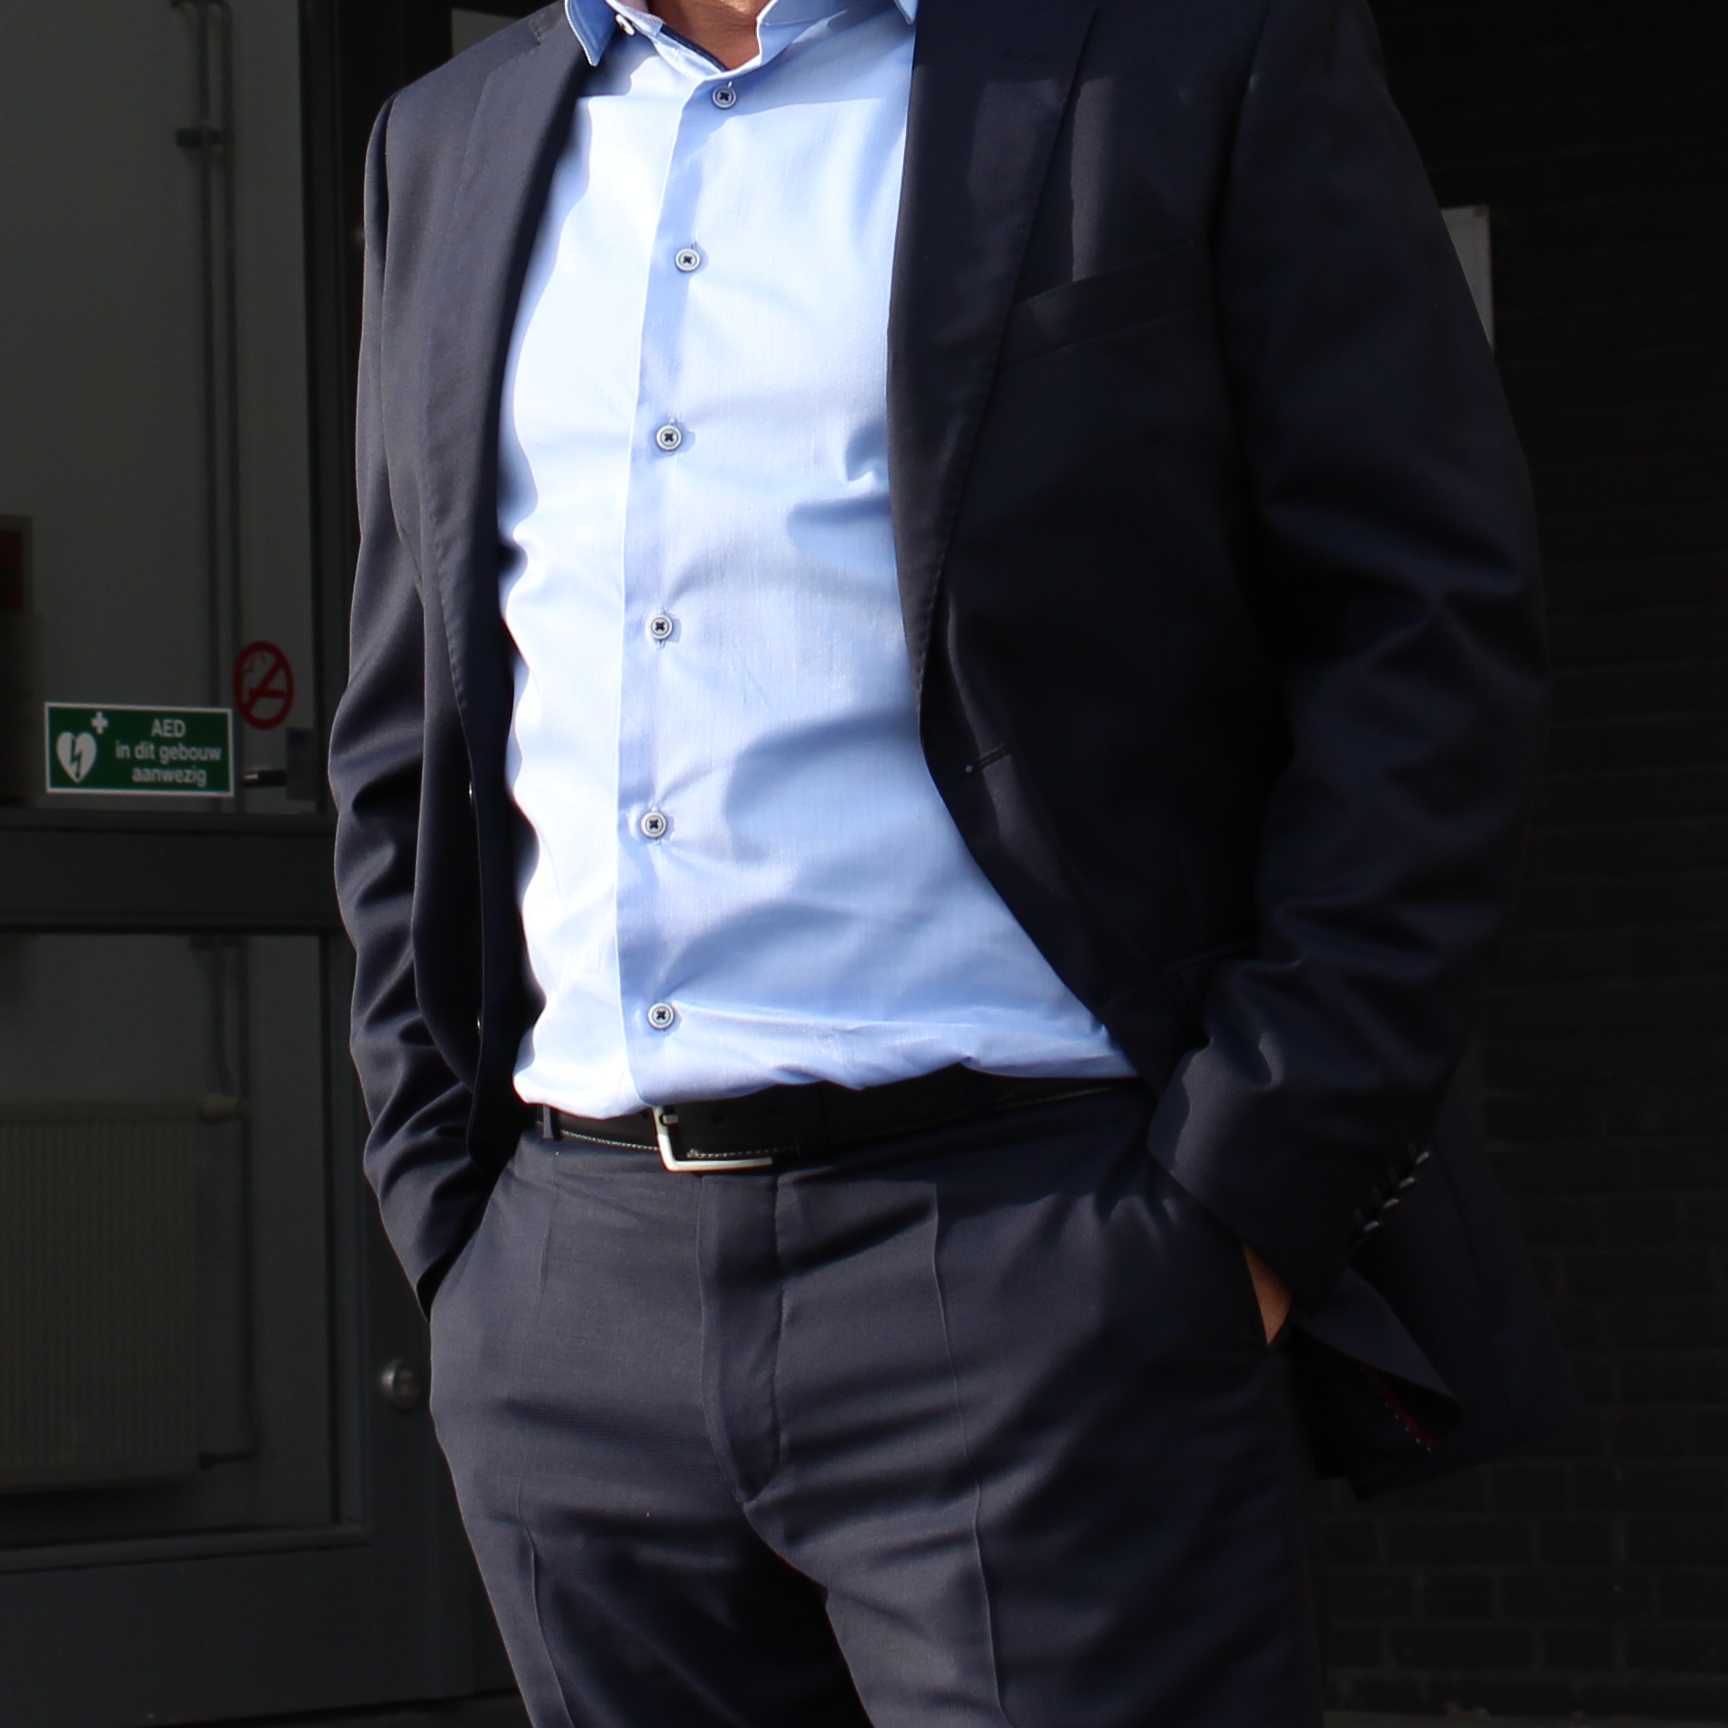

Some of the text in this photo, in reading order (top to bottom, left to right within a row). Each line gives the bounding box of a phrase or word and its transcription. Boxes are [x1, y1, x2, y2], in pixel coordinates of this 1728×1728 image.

[150, 718, 187, 738] AED
[115, 739, 222, 765] in dit gebouw
[132, 765, 207, 788] aanwezig
